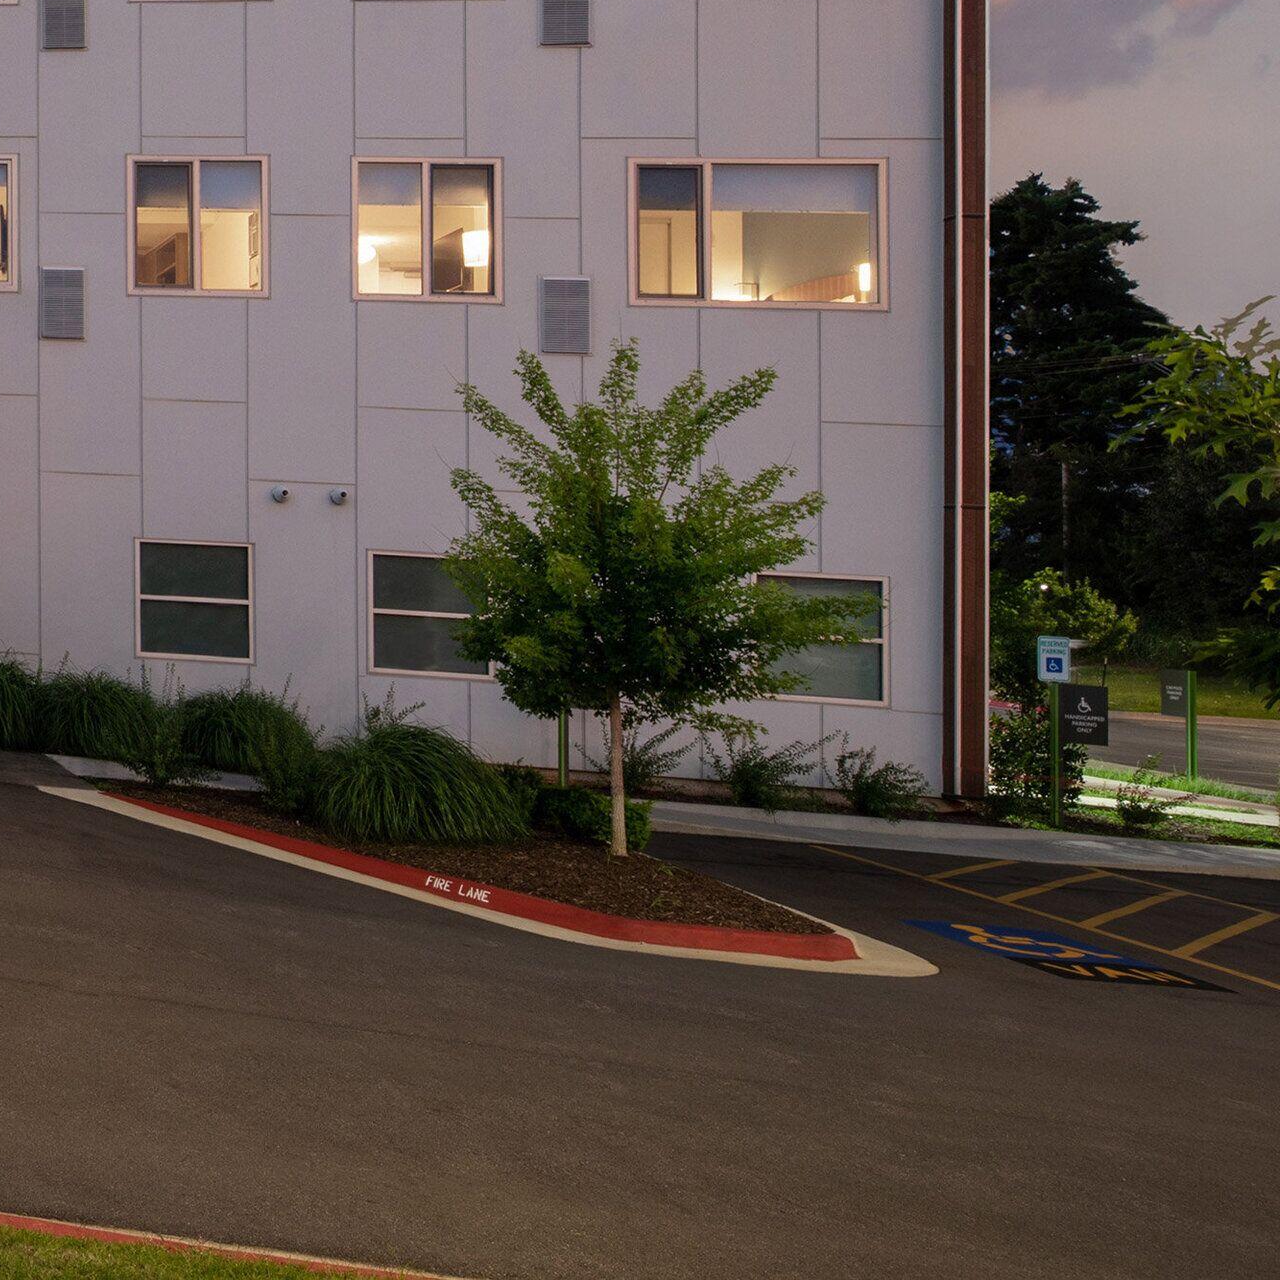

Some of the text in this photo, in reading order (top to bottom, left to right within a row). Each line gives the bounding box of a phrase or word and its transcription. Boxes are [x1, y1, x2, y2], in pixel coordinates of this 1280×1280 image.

[1064, 713, 1105, 722] HANDICAPPED
[1071, 720, 1097, 728] PARKING
[425, 875, 491, 903] FIRE LANE
